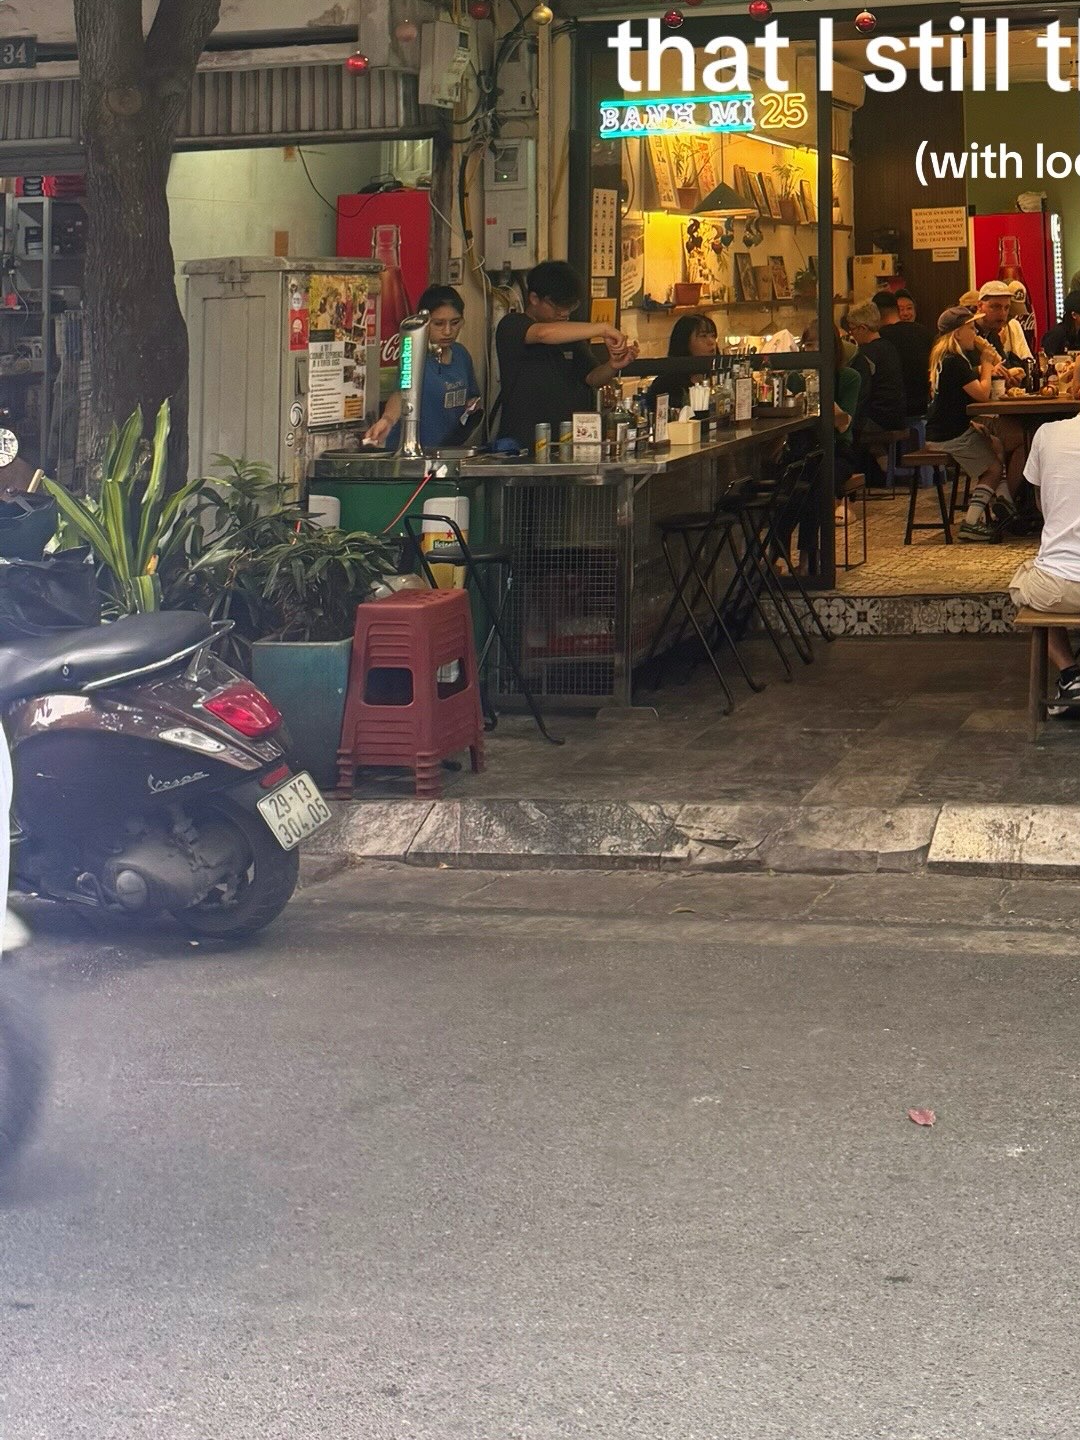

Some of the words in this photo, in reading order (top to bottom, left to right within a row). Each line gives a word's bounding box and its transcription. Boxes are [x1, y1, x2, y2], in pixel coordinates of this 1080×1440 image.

[3, 42, 27, 63] 34
[600, 101, 697, 133] BANH
[709, 99, 757, 128] MI
[760, 93, 809, 129] 25
[401, 337, 412, 389] Heineken
[269, 779, 312, 820] 29-Y3
[278, 798, 329, 845] 304.05
